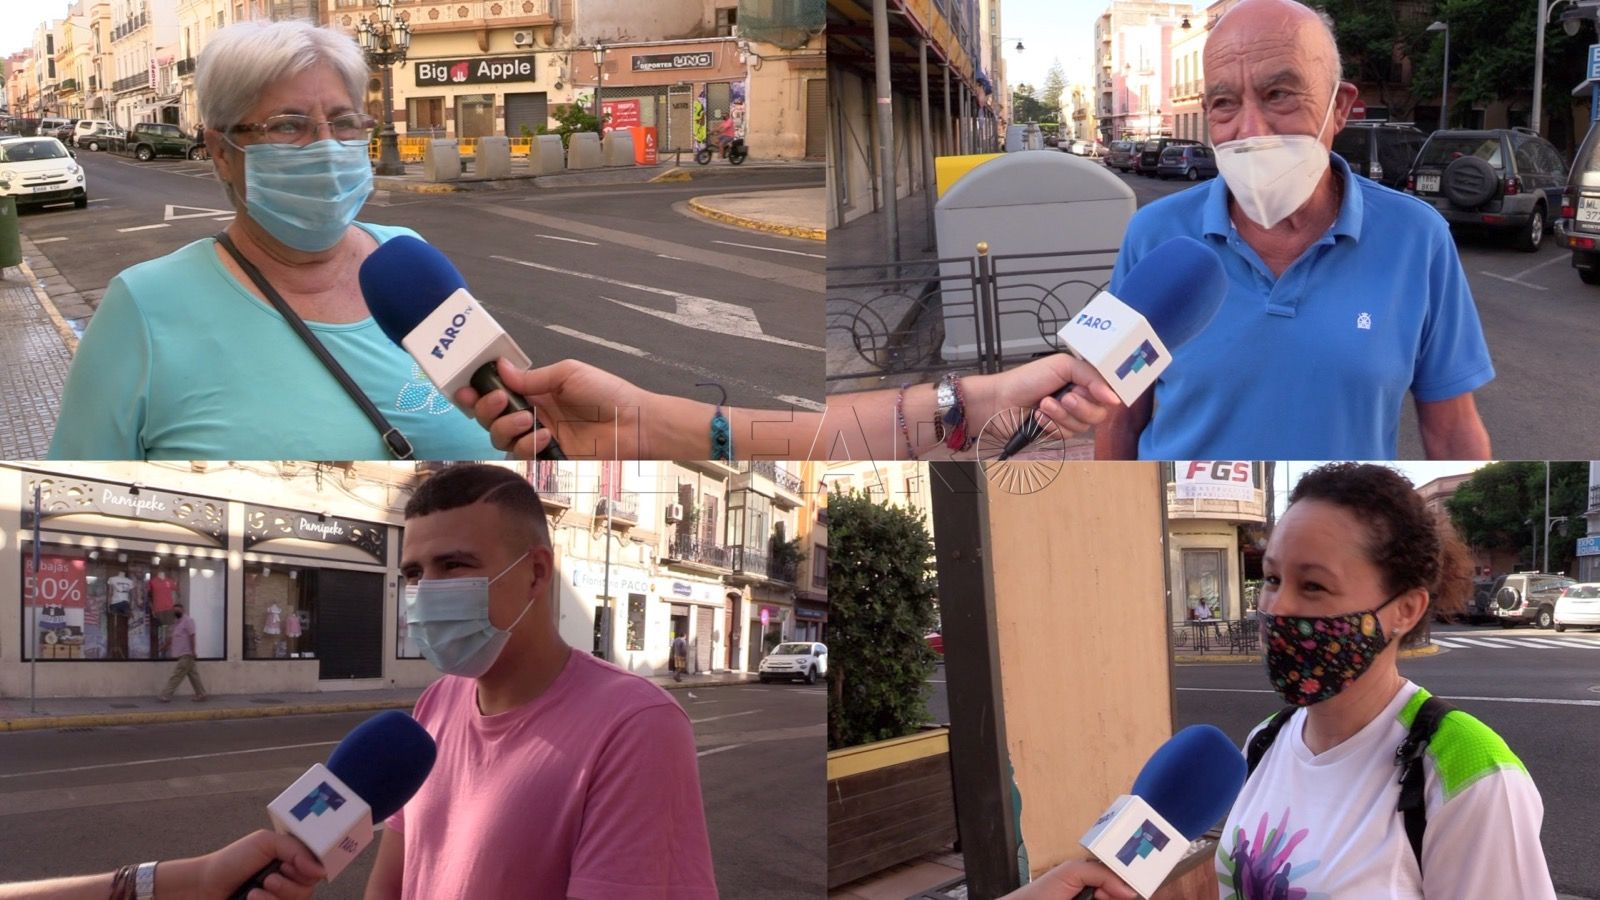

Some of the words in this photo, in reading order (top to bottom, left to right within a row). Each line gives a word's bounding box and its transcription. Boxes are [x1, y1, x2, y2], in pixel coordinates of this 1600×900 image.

[419, 63, 448, 82] Big
[477, 59, 531, 80] Apple
[640, 62, 673, 70] DEPORTES
[673, 54, 711, 68] UNO
[1076, 314, 1112, 331] FARO
[431, 313, 466, 360] FARO
[1186, 461, 1249, 482] FGS
[26, 559, 69, 573] Rbajas
[24, 576, 81, 601] 50%
